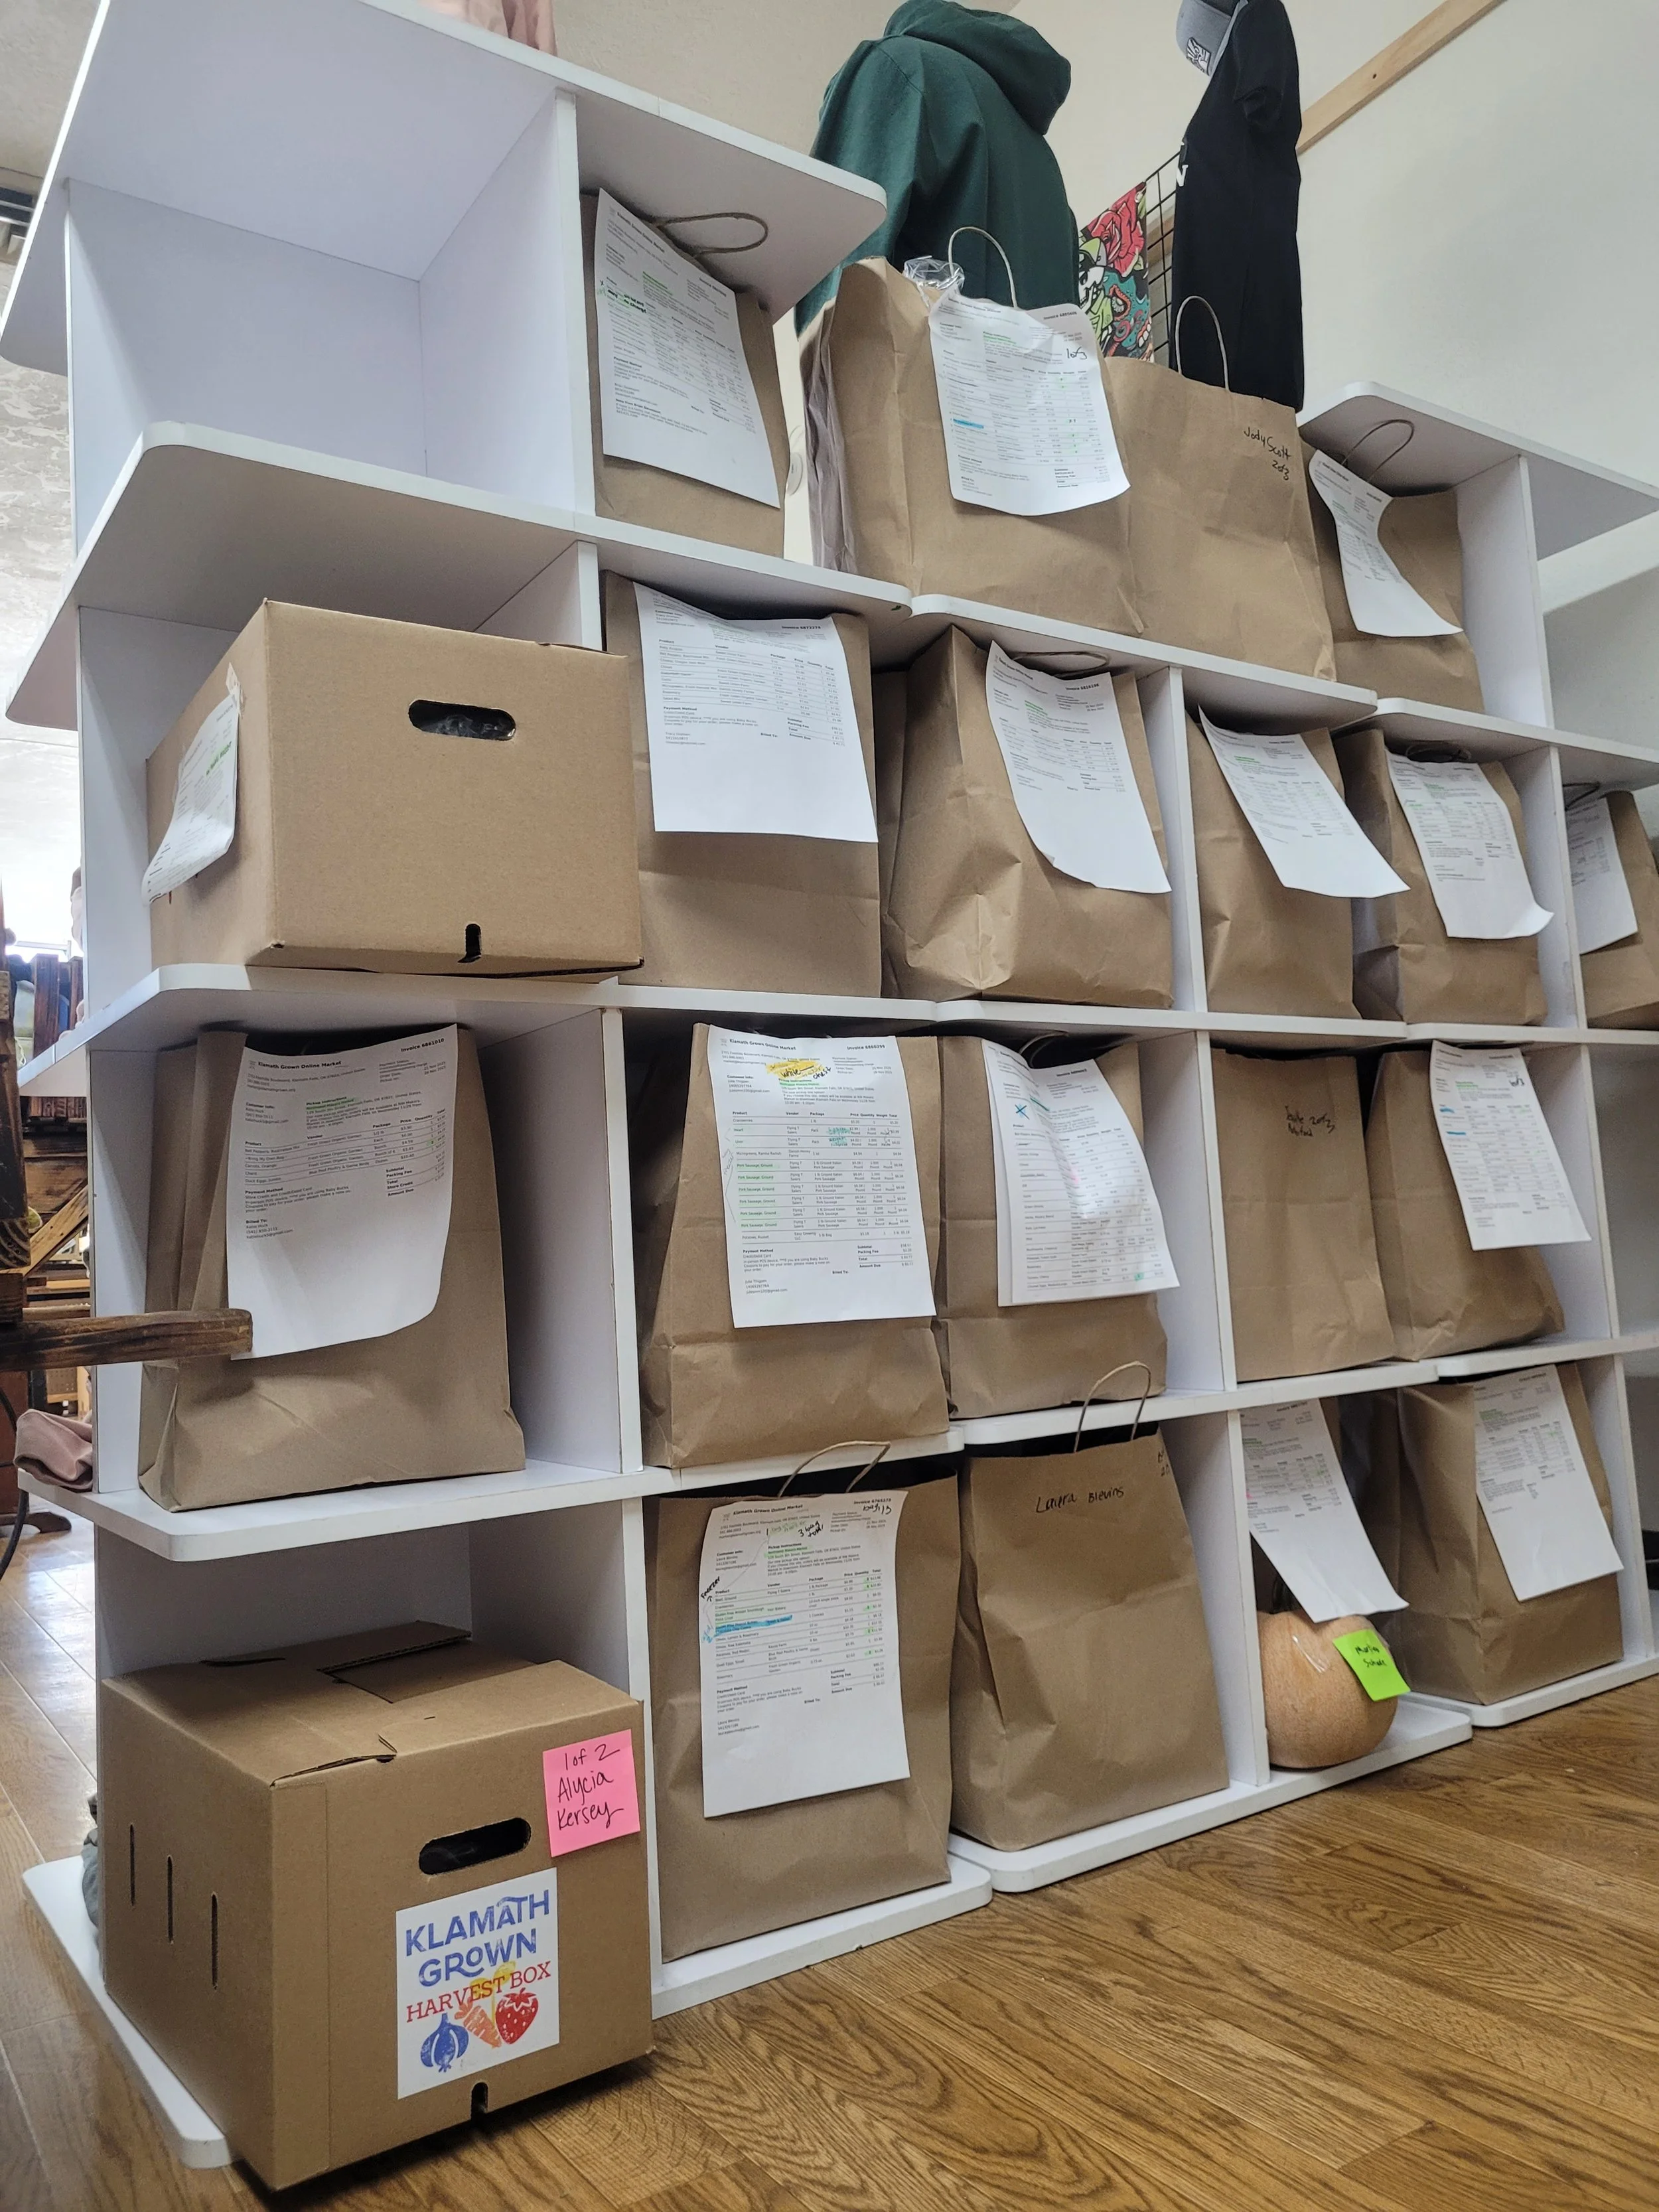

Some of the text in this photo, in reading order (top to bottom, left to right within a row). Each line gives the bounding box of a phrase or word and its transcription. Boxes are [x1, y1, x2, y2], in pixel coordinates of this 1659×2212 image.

[421, 1038, 445, 1047] 6861010
[1036, 1487, 1124, 1514] Laura Blevins
[565, 1744, 620, 1771] 1 of 2
[557, 1771, 614, 1806] Alycia
[557, 1801, 624, 1830] Kersey
[405, 1889, 549, 1956] KLAMATH
[418, 1928, 536, 1987] GROWN
[406, 1960, 551, 2023] HARVEST BOX
